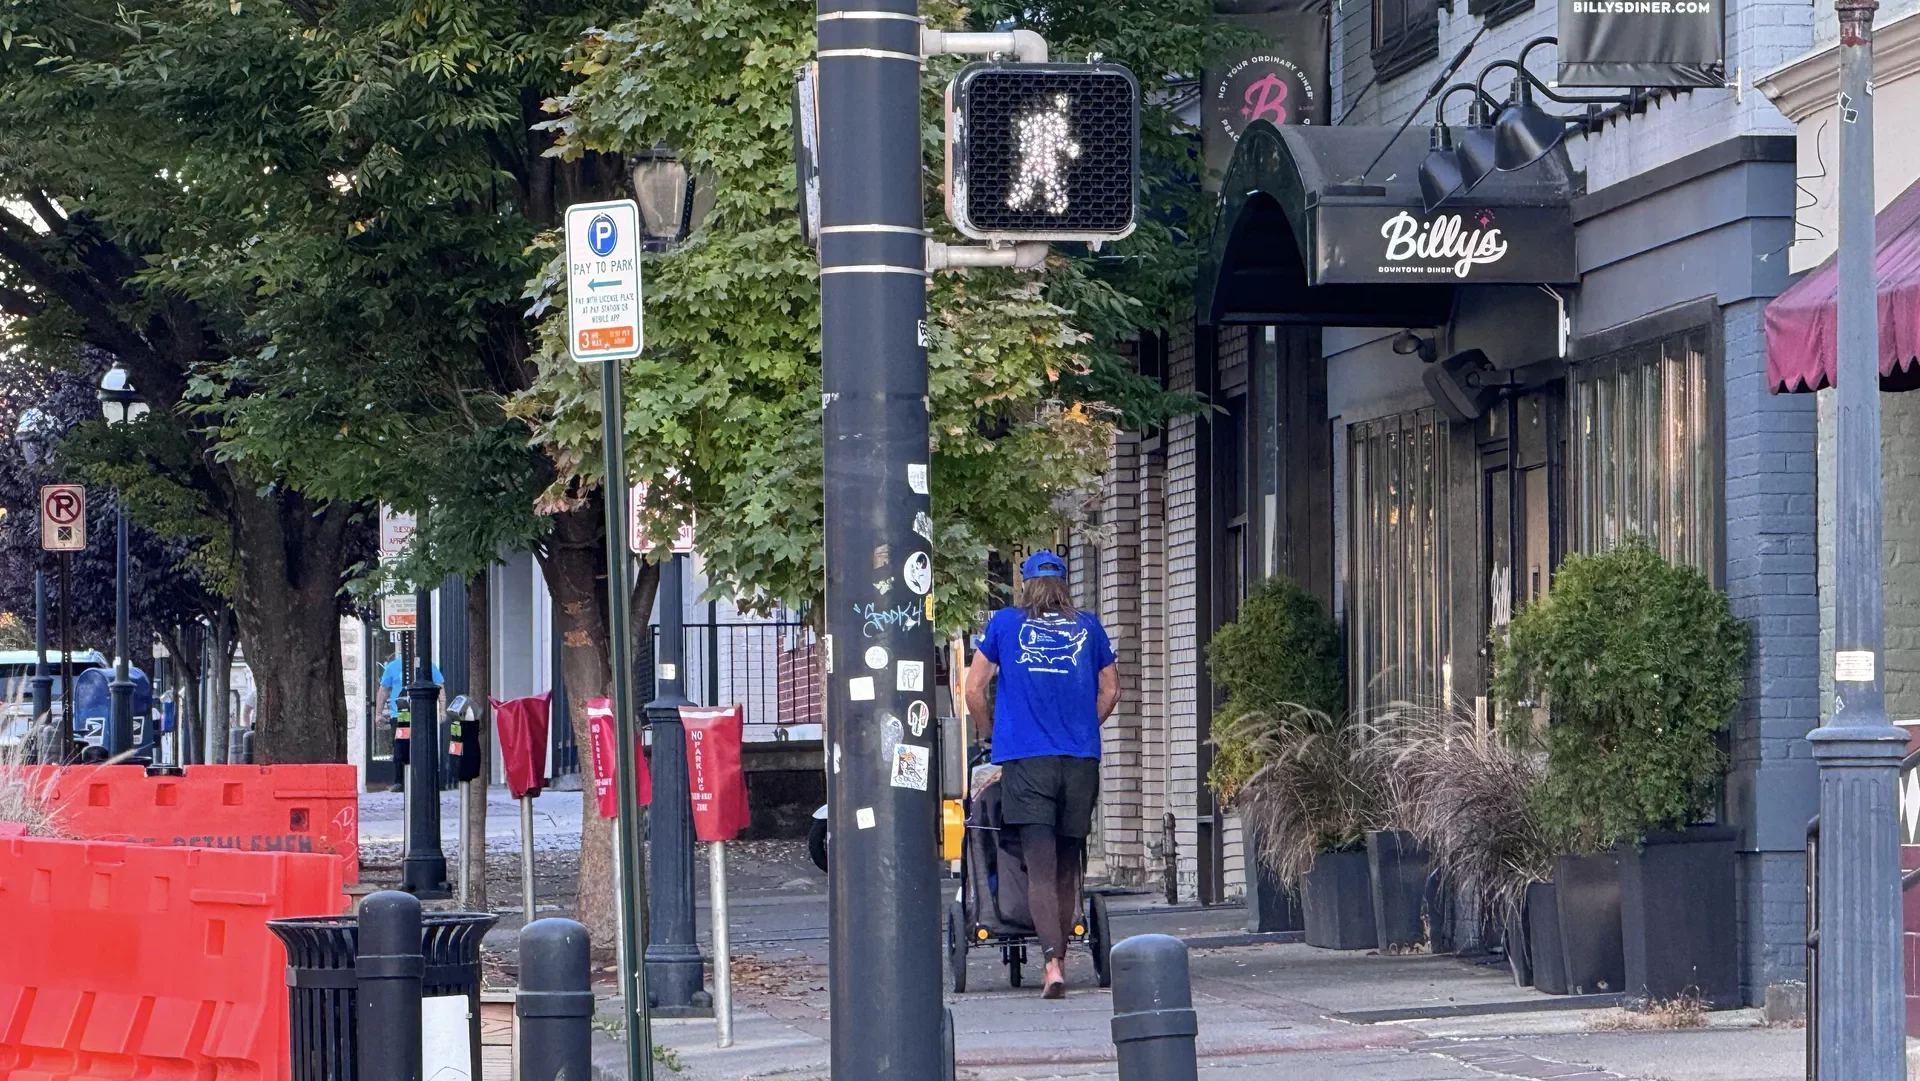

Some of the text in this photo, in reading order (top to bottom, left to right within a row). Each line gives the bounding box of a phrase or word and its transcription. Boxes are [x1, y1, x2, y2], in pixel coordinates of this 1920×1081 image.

[1573, 1, 1710, 13] BILLYSDINER.COM
[1218, 81, 1228, 99] NOT
[1227, 60, 1249, 78] YOUR
[1251, 55, 1297, 71] ORDINARY
[1221, 119, 1240, 142] PEAC
[574, 258, 633, 275] PAY TO PARK
[581, 331, 590, 349] 3
[691, 730, 703, 740] NO
[694, 741, 704, 791] PARKING
